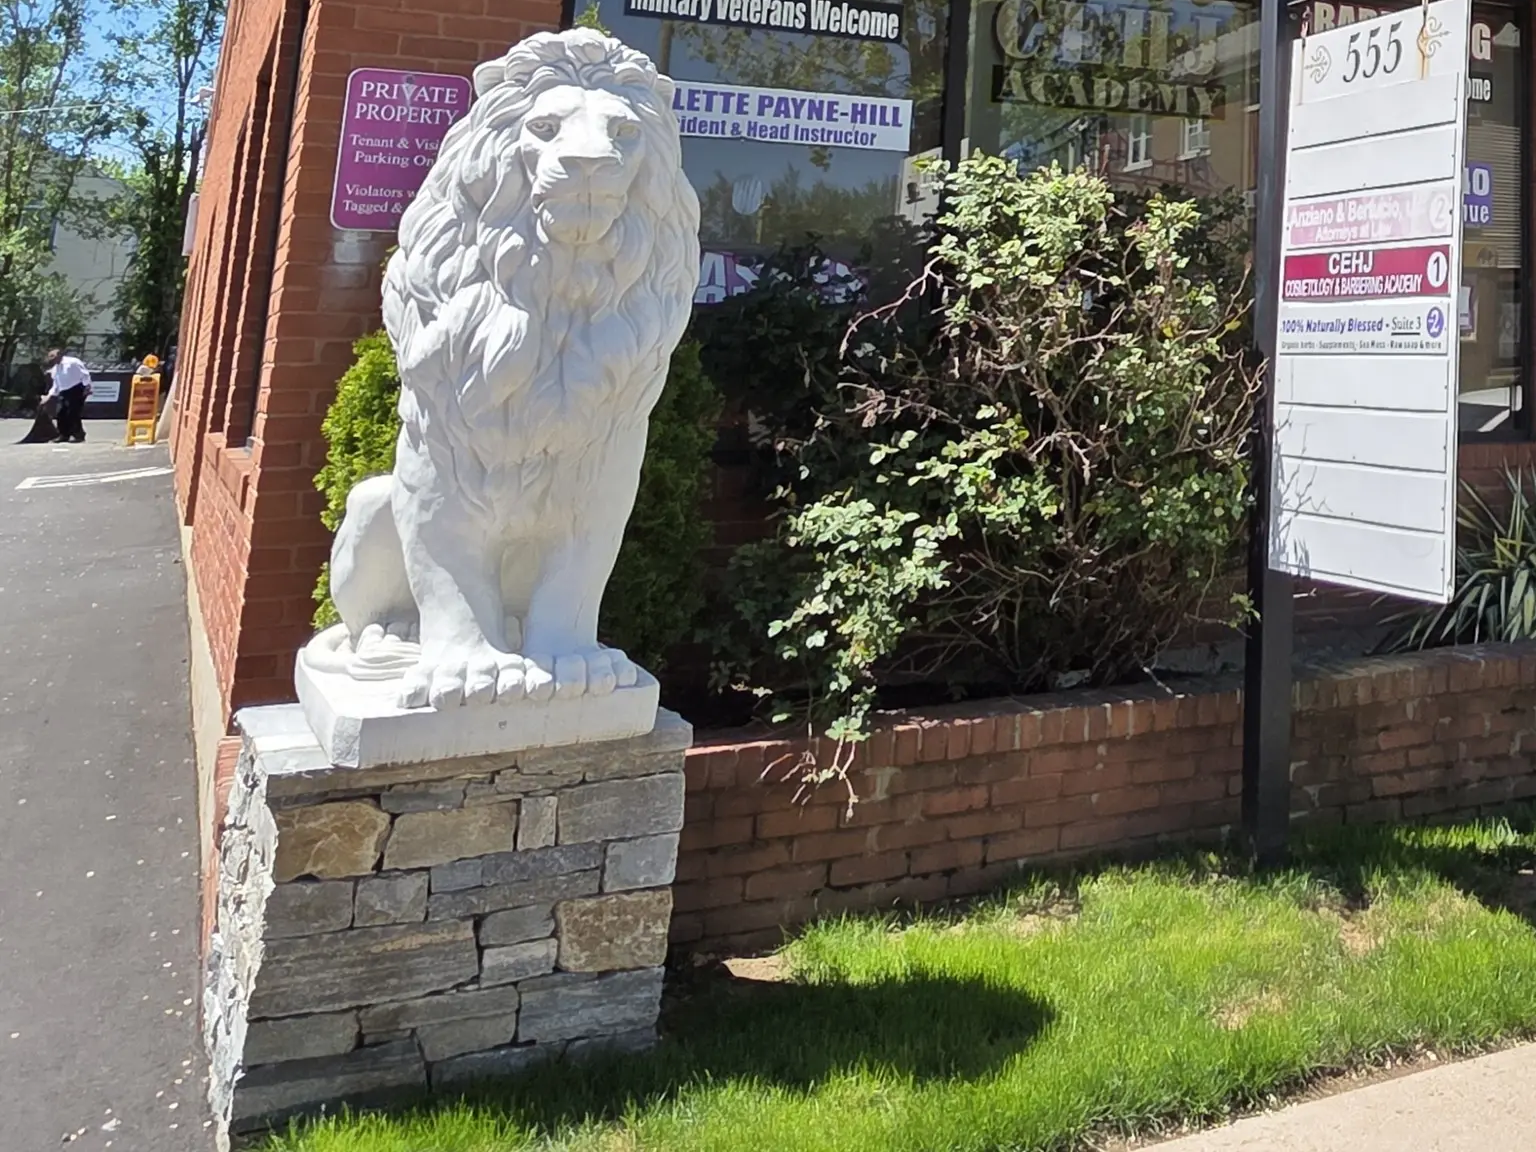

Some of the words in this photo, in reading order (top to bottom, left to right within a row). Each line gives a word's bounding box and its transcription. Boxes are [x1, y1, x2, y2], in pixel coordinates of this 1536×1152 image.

[1342, 20, 1403, 83] 555
[360, 81, 459, 104] PRIVATE
[999, 67, 1225, 116] ACADEMY
[354, 102, 459, 125] PROPERTY
[672, 88, 750, 115] LETTE
[756, 91, 903, 128] PAYNE-HILL
[350, 134, 393, 148] Tenant
[397, 137, 409, 149] &
[414, 139, 440, 151] Visi
[677, 116, 726, 135] ident
[731, 122, 742, 136] &
[747, 120, 790, 141] Head
[794, 122, 877, 148] Instructor
[354, 151, 410, 168] Parking
[413, 155, 435, 167] On
[345, 184, 403, 198] Violators
[342, 200, 389, 214] Tagged
[391, 202, 402, 213] &
[1336, 201, 1346, 222] &
[1435, 198, 1446, 222] 2
[1328, 251, 1373, 275] CEHJ
[1433, 256, 1441, 282] 1
[1285, 278, 1334, 297] COSMETOLOGY
[1334, 278, 1340, 296] &
[1341, 276, 1383, 296] BARBERING
[1384, 274, 1423, 294] ACADEMY
[1282, 320, 1304, 333] 100%
[1306, 318, 1346, 334] Naturally
[1348, 317, 1383, 332] Blessed
[1391, 316, 1415, 330] Suite
[1416, 316, 1422, 330] 3
